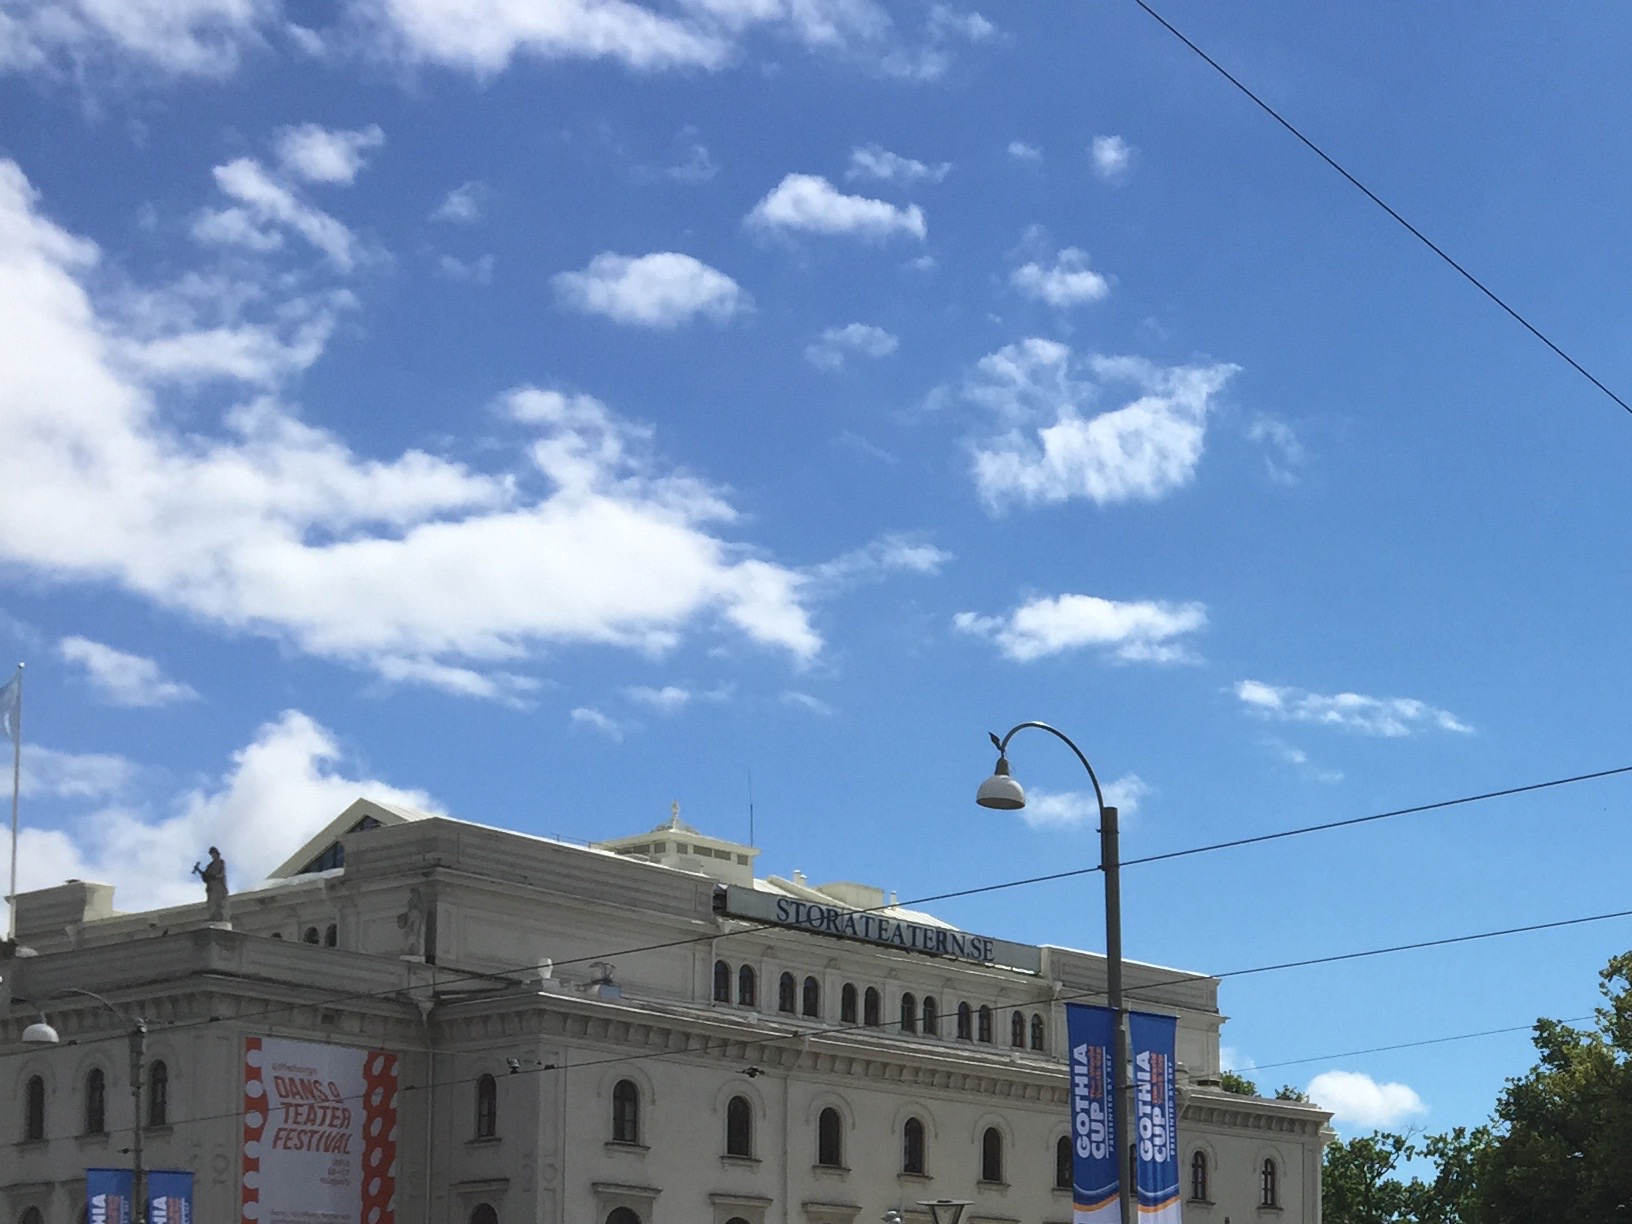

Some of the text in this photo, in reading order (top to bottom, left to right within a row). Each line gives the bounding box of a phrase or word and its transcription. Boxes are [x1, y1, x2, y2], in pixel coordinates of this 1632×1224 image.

[776, 898, 995, 962] STORATEATERN.SE
[273, 1075, 330, 1103] DANS
[281, 1102, 353, 1130] TEATER
[1073, 1043, 1091, 1158] GOTHIA
[1136, 1050, 1153, 1161] GOTHIA
[272, 1127, 354, 1155] FESTIVAL
[1090, 1101, 1106, 1160] CUP
[1152, 1106, 1167, 1163] CUP
